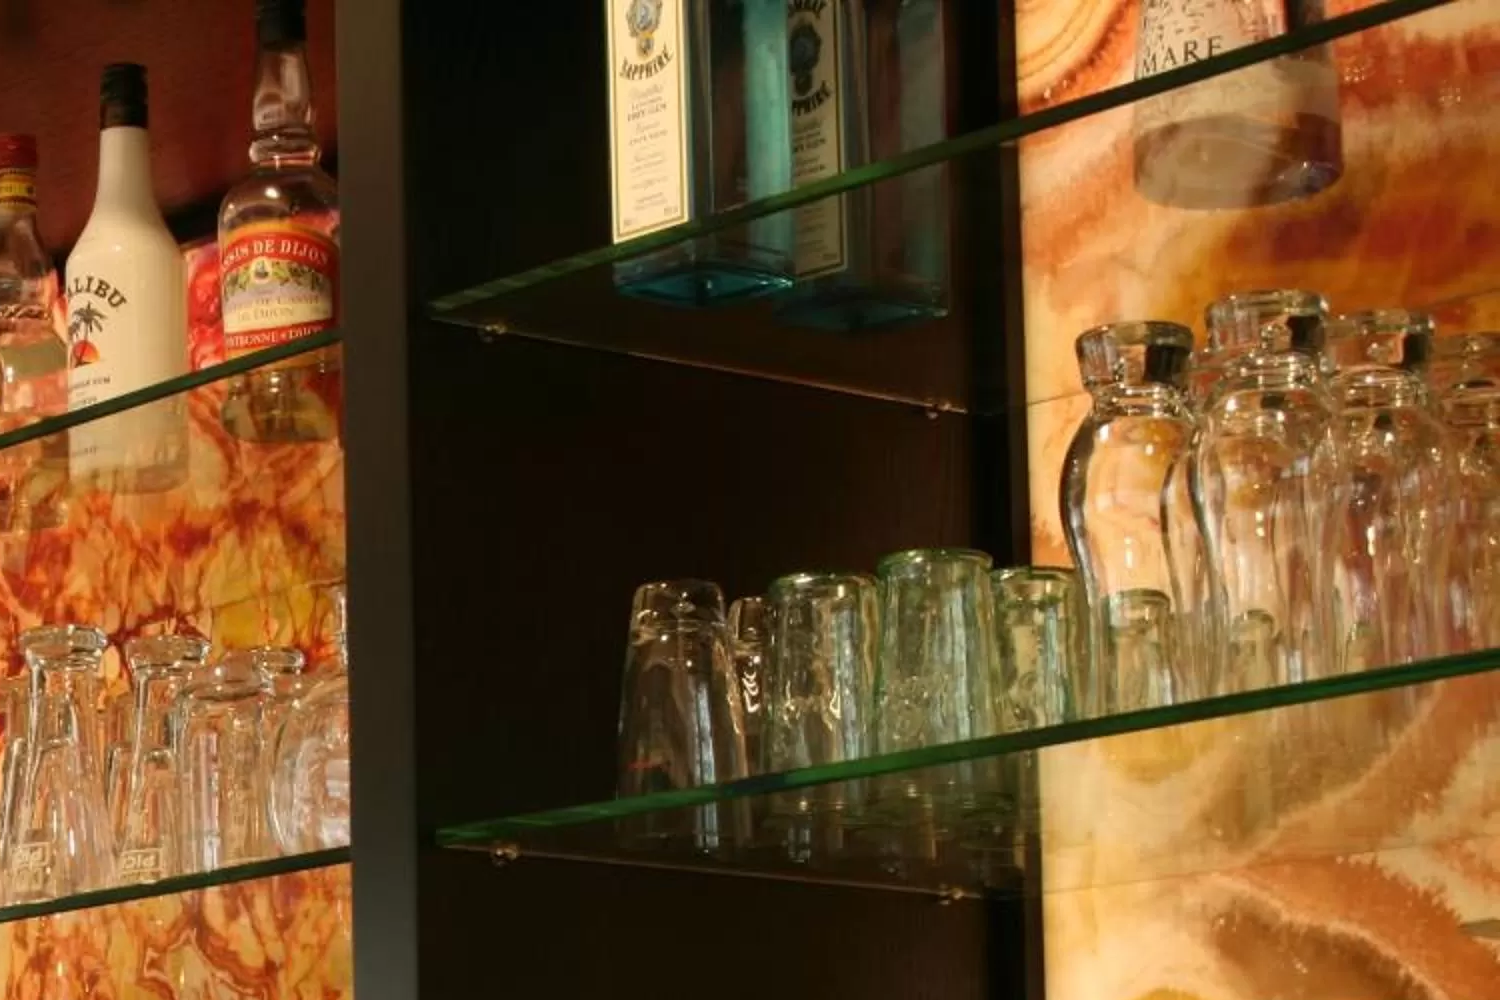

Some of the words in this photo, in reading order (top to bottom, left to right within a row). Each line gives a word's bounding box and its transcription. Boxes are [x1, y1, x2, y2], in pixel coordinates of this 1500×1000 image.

[619, 42, 674, 81] SAPPHIRE
[253, 239, 275, 254] DE
[281, 239, 328, 265] DIJON
